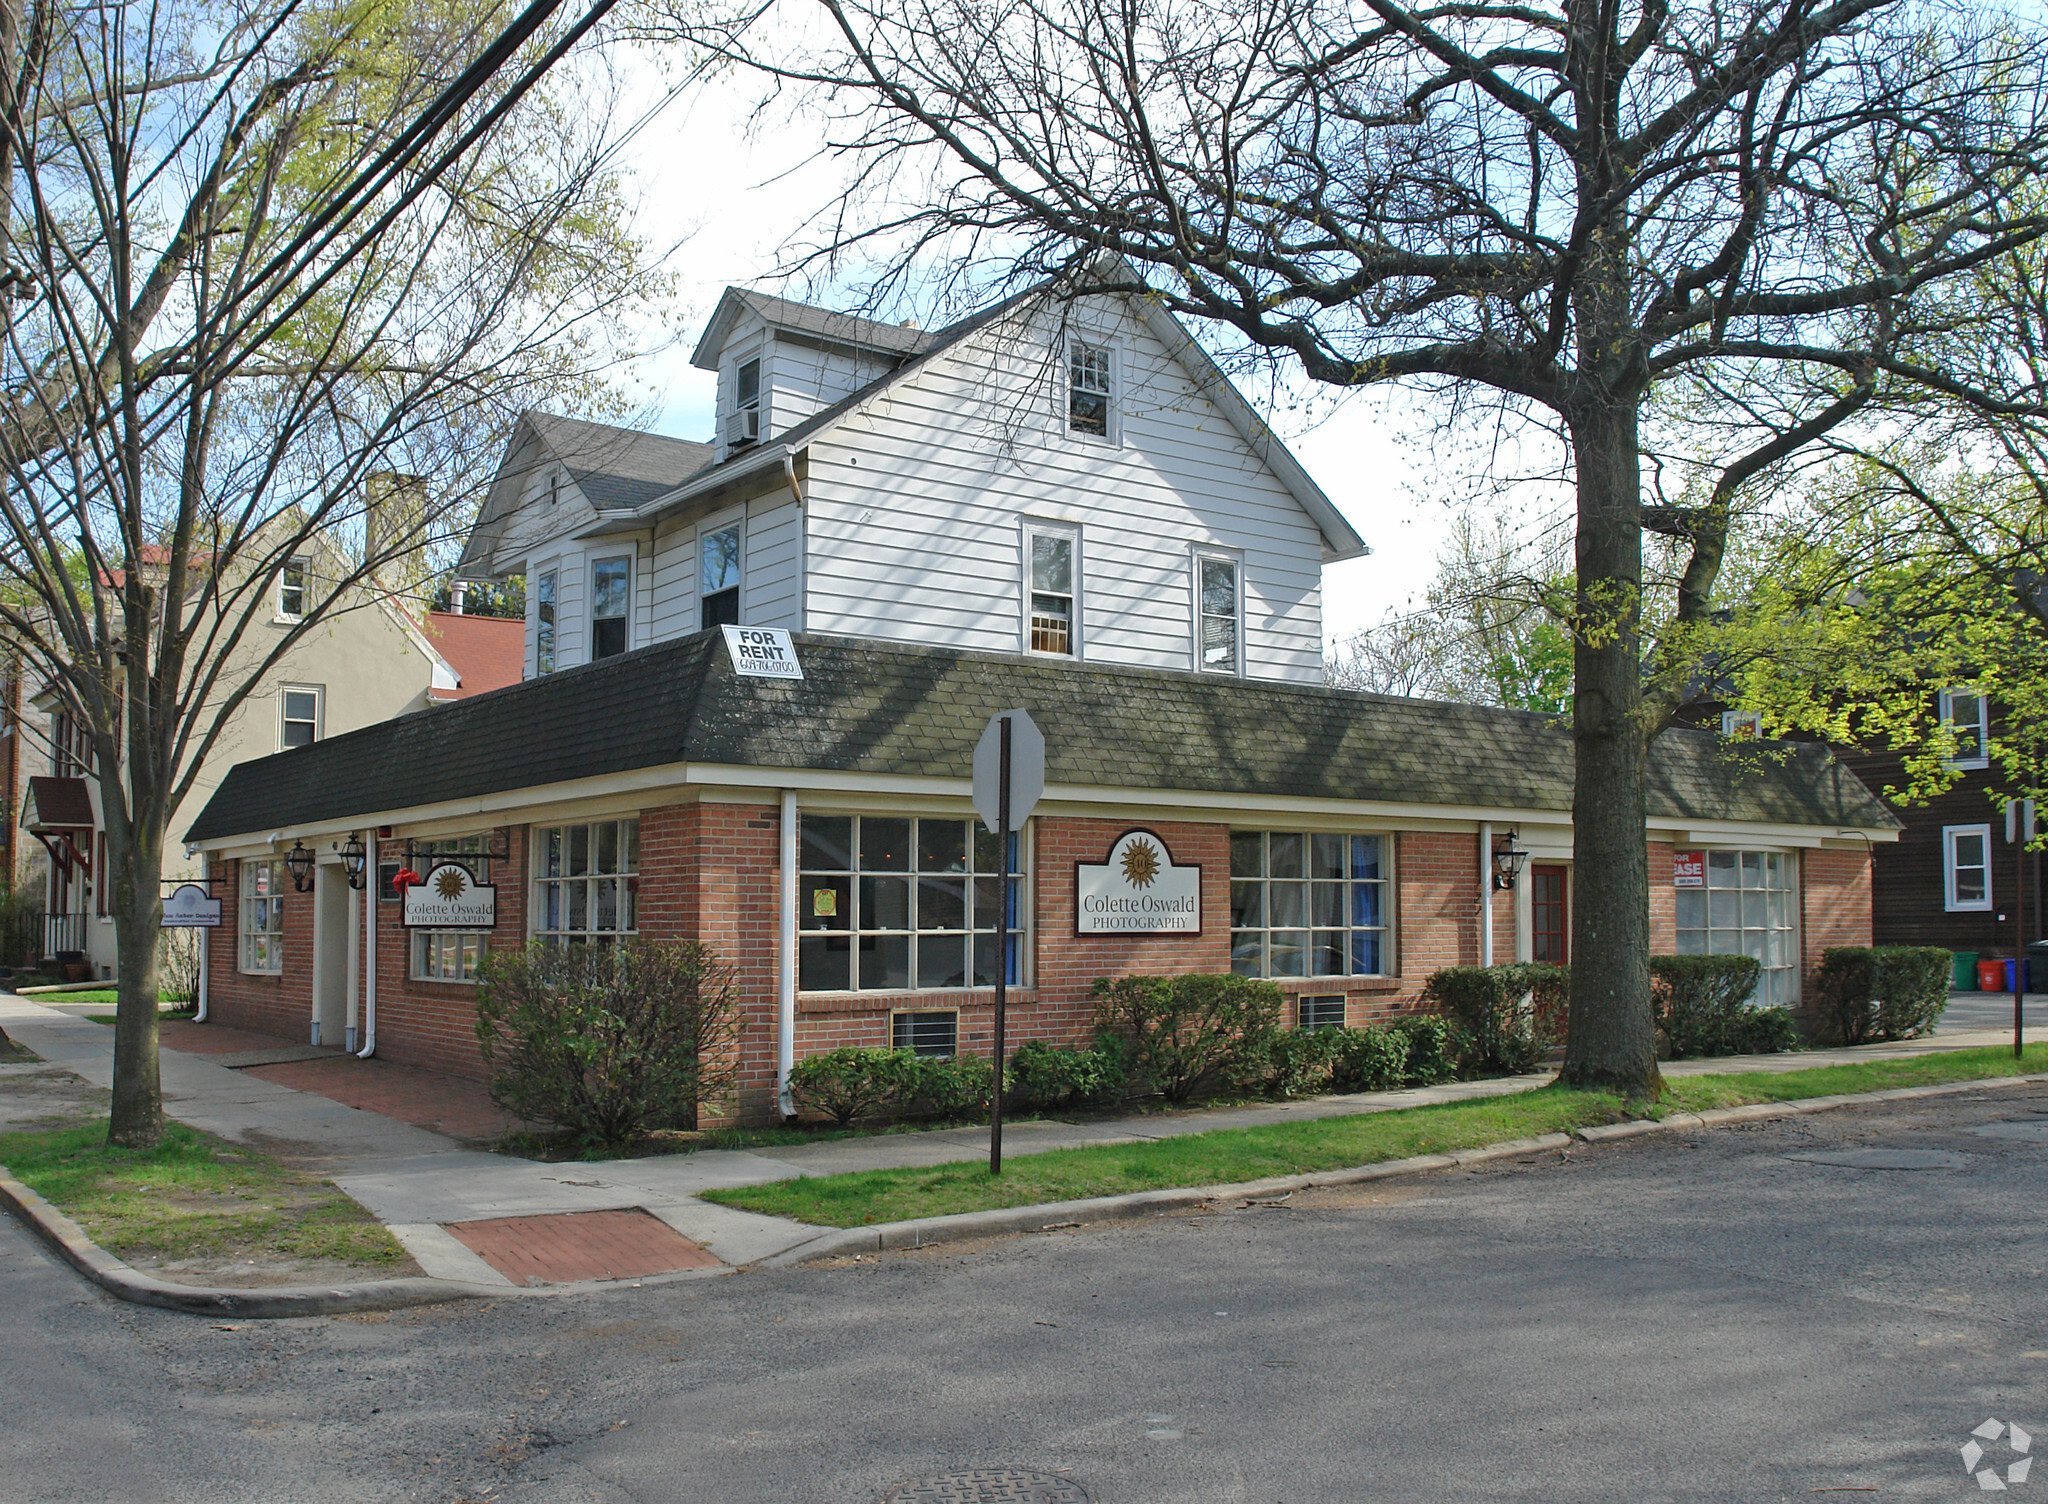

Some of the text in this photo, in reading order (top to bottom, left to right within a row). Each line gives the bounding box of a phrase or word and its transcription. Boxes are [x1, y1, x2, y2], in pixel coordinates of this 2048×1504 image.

[739, 631, 776, 645] FOR
[738, 645, 784, 660] RENT
[406, 903, 493, 915] Colette Oswald
[1084, 895, 1195, 913] Colette Oswald
[411, 915, 487, 923] PHOTOGRAPHY
[1093, 917, 1188, 929] PHOTOGRAPHY
